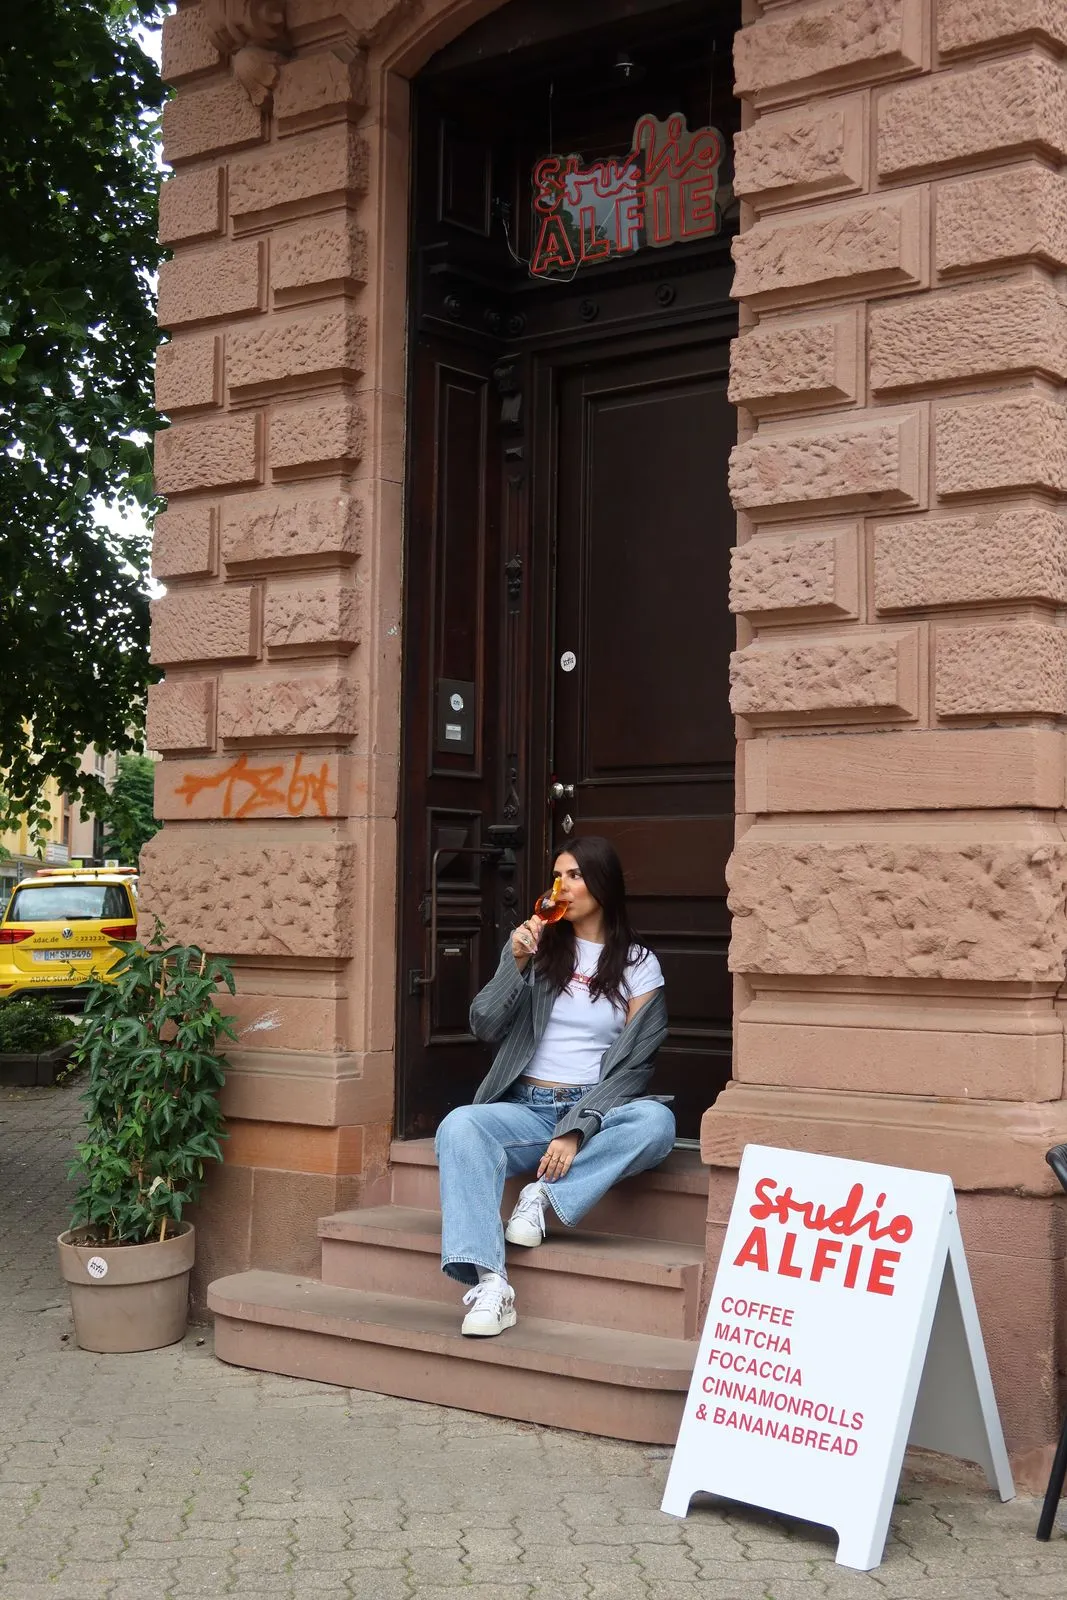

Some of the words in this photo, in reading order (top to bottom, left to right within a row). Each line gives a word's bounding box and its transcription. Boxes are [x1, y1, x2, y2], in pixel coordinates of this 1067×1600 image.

[533, 117, 720, 213] Studio
[531, 173, 717, 273] ALFIE
[750, 1177, 913, 1243] Studio
[733, 1226, 901, 1296] ALFIE
[714, 1322, 792, 1355] MATCHA
[721, 1296, 795, 1327] COFFEE
[708, 1349, 803, 1386] FOCACCIA
[695, 1403, 708, 1421] &
[713, 1407, 859, 1457] BANANABREAD
[702, 1376, 864, 1431] CINNAMONROLLS
